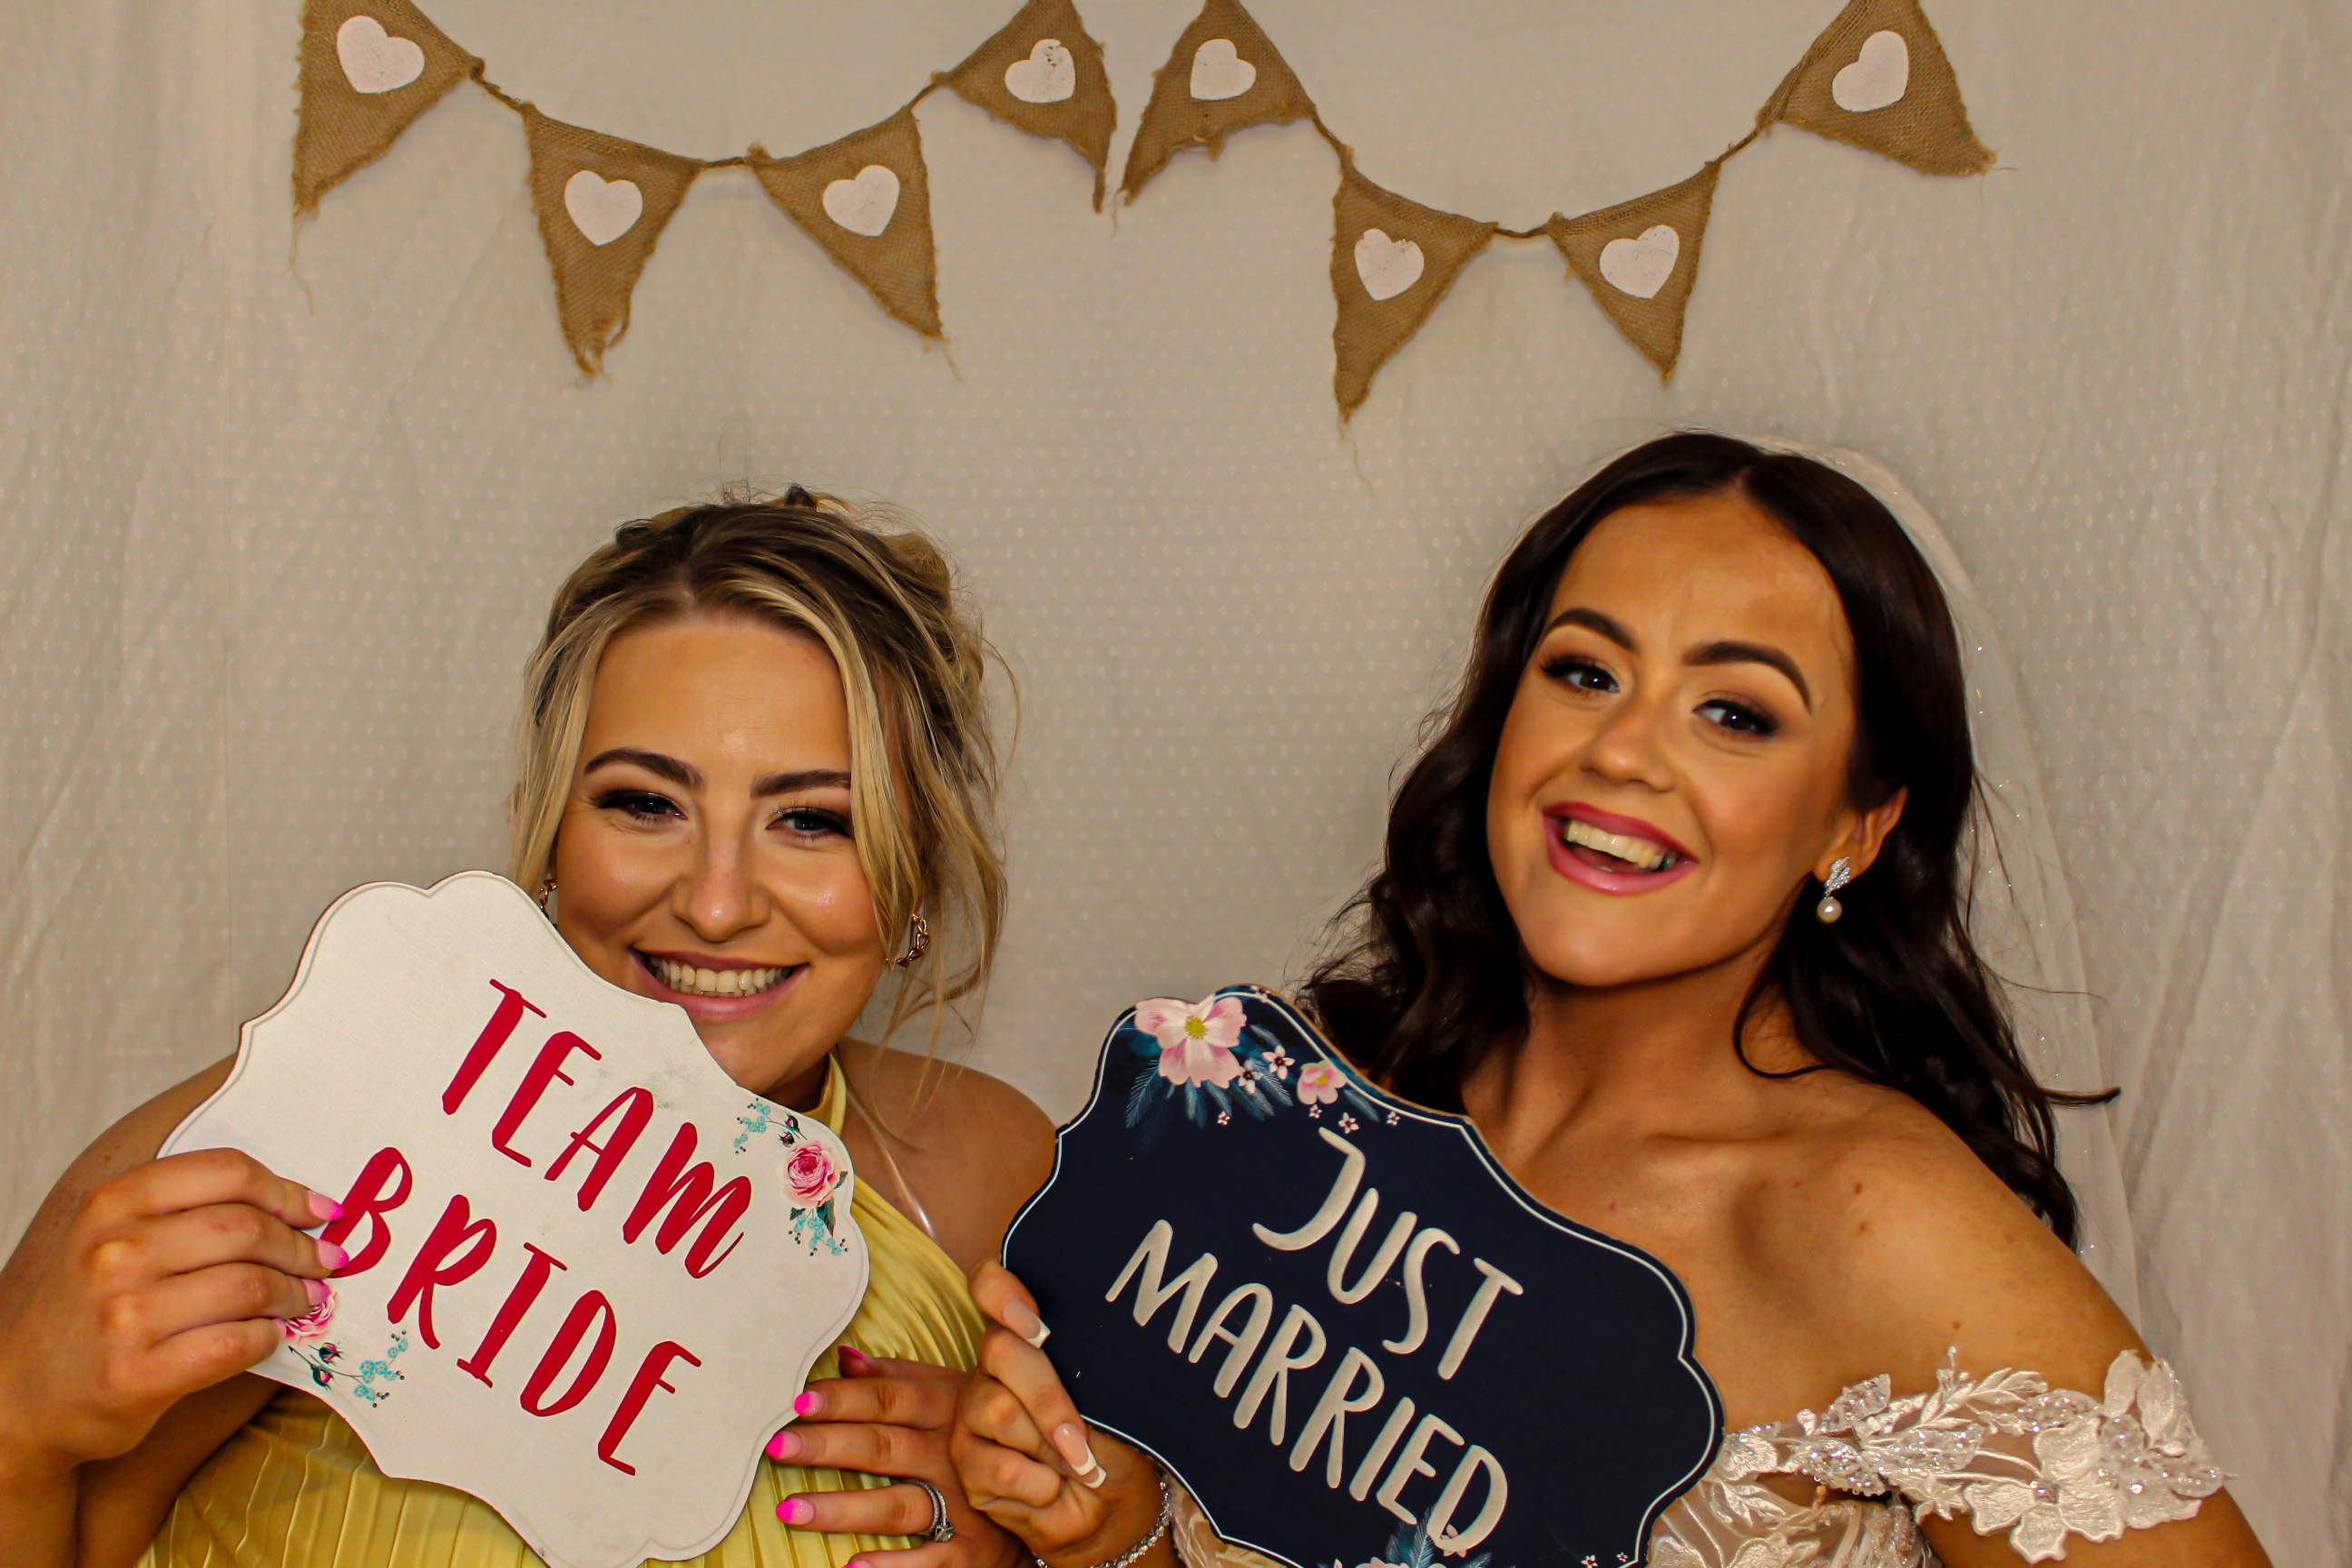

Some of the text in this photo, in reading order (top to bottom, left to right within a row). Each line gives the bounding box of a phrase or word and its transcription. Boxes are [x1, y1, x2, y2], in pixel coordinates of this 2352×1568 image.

[442, 978, 752, 1279] TEAM
[1253, 1127, 1524, 1380] JUST
[320, 1147, 701, 1475] BRIDE
[1105, 1220, 1508, 1553] MARRIED
